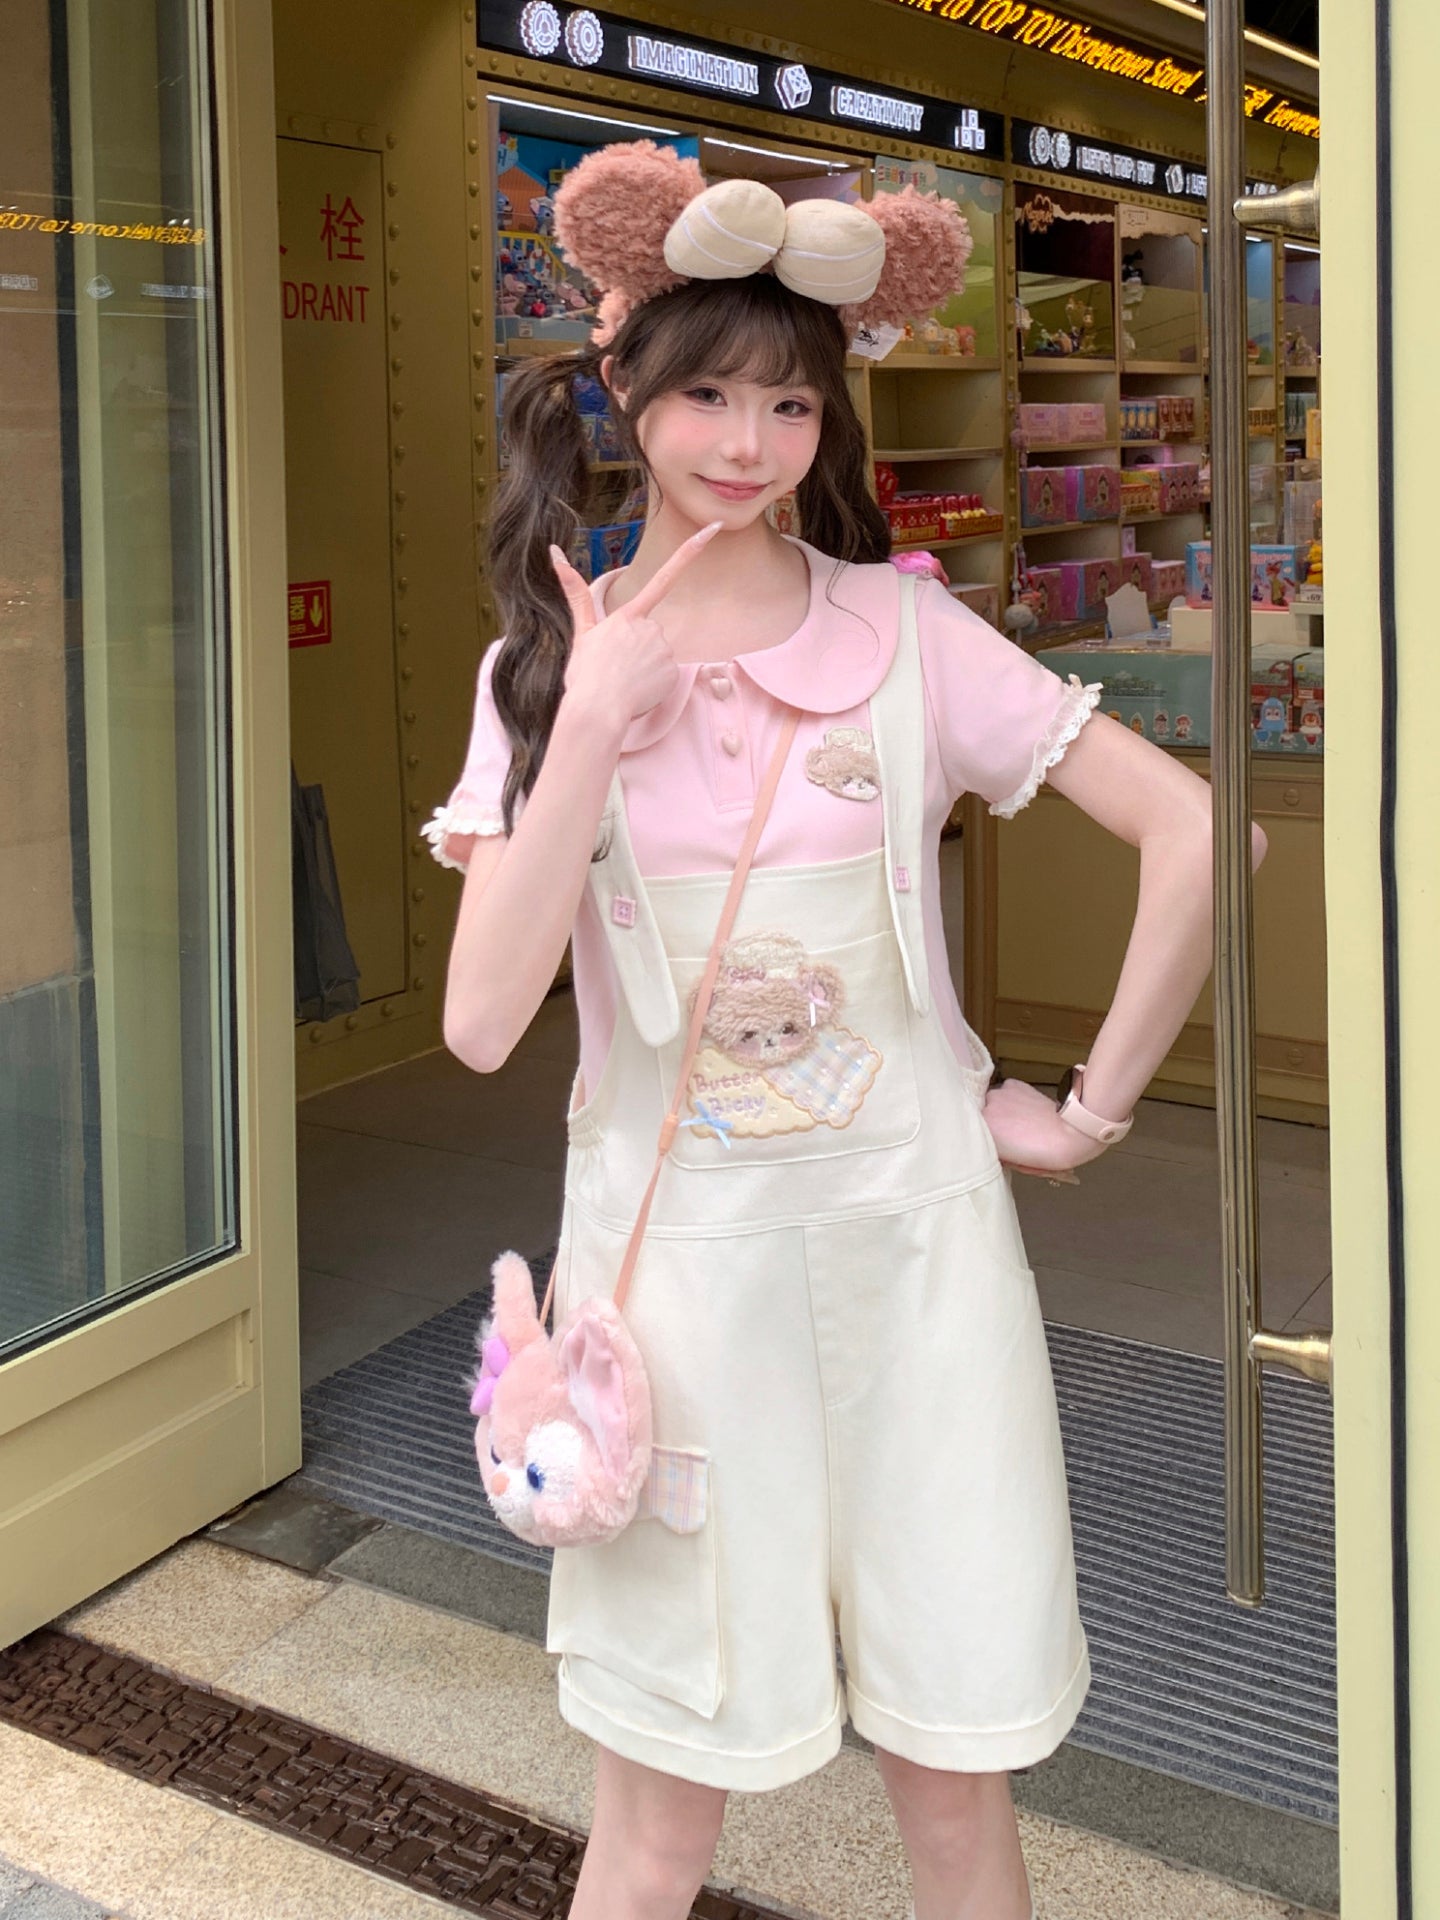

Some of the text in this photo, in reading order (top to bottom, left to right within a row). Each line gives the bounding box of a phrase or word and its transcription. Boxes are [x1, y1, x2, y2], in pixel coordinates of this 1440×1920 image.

[968, 0, 1027, 33] TOP
[1013, 10, 1069, 48] TOY
[634, 36, 760, 95] IMAGINATION
[836, 86, 924, 131] CREATIVITY
[282, 281, 370, 323] DRANT
[692, 1071, 760, 1093] Butter
